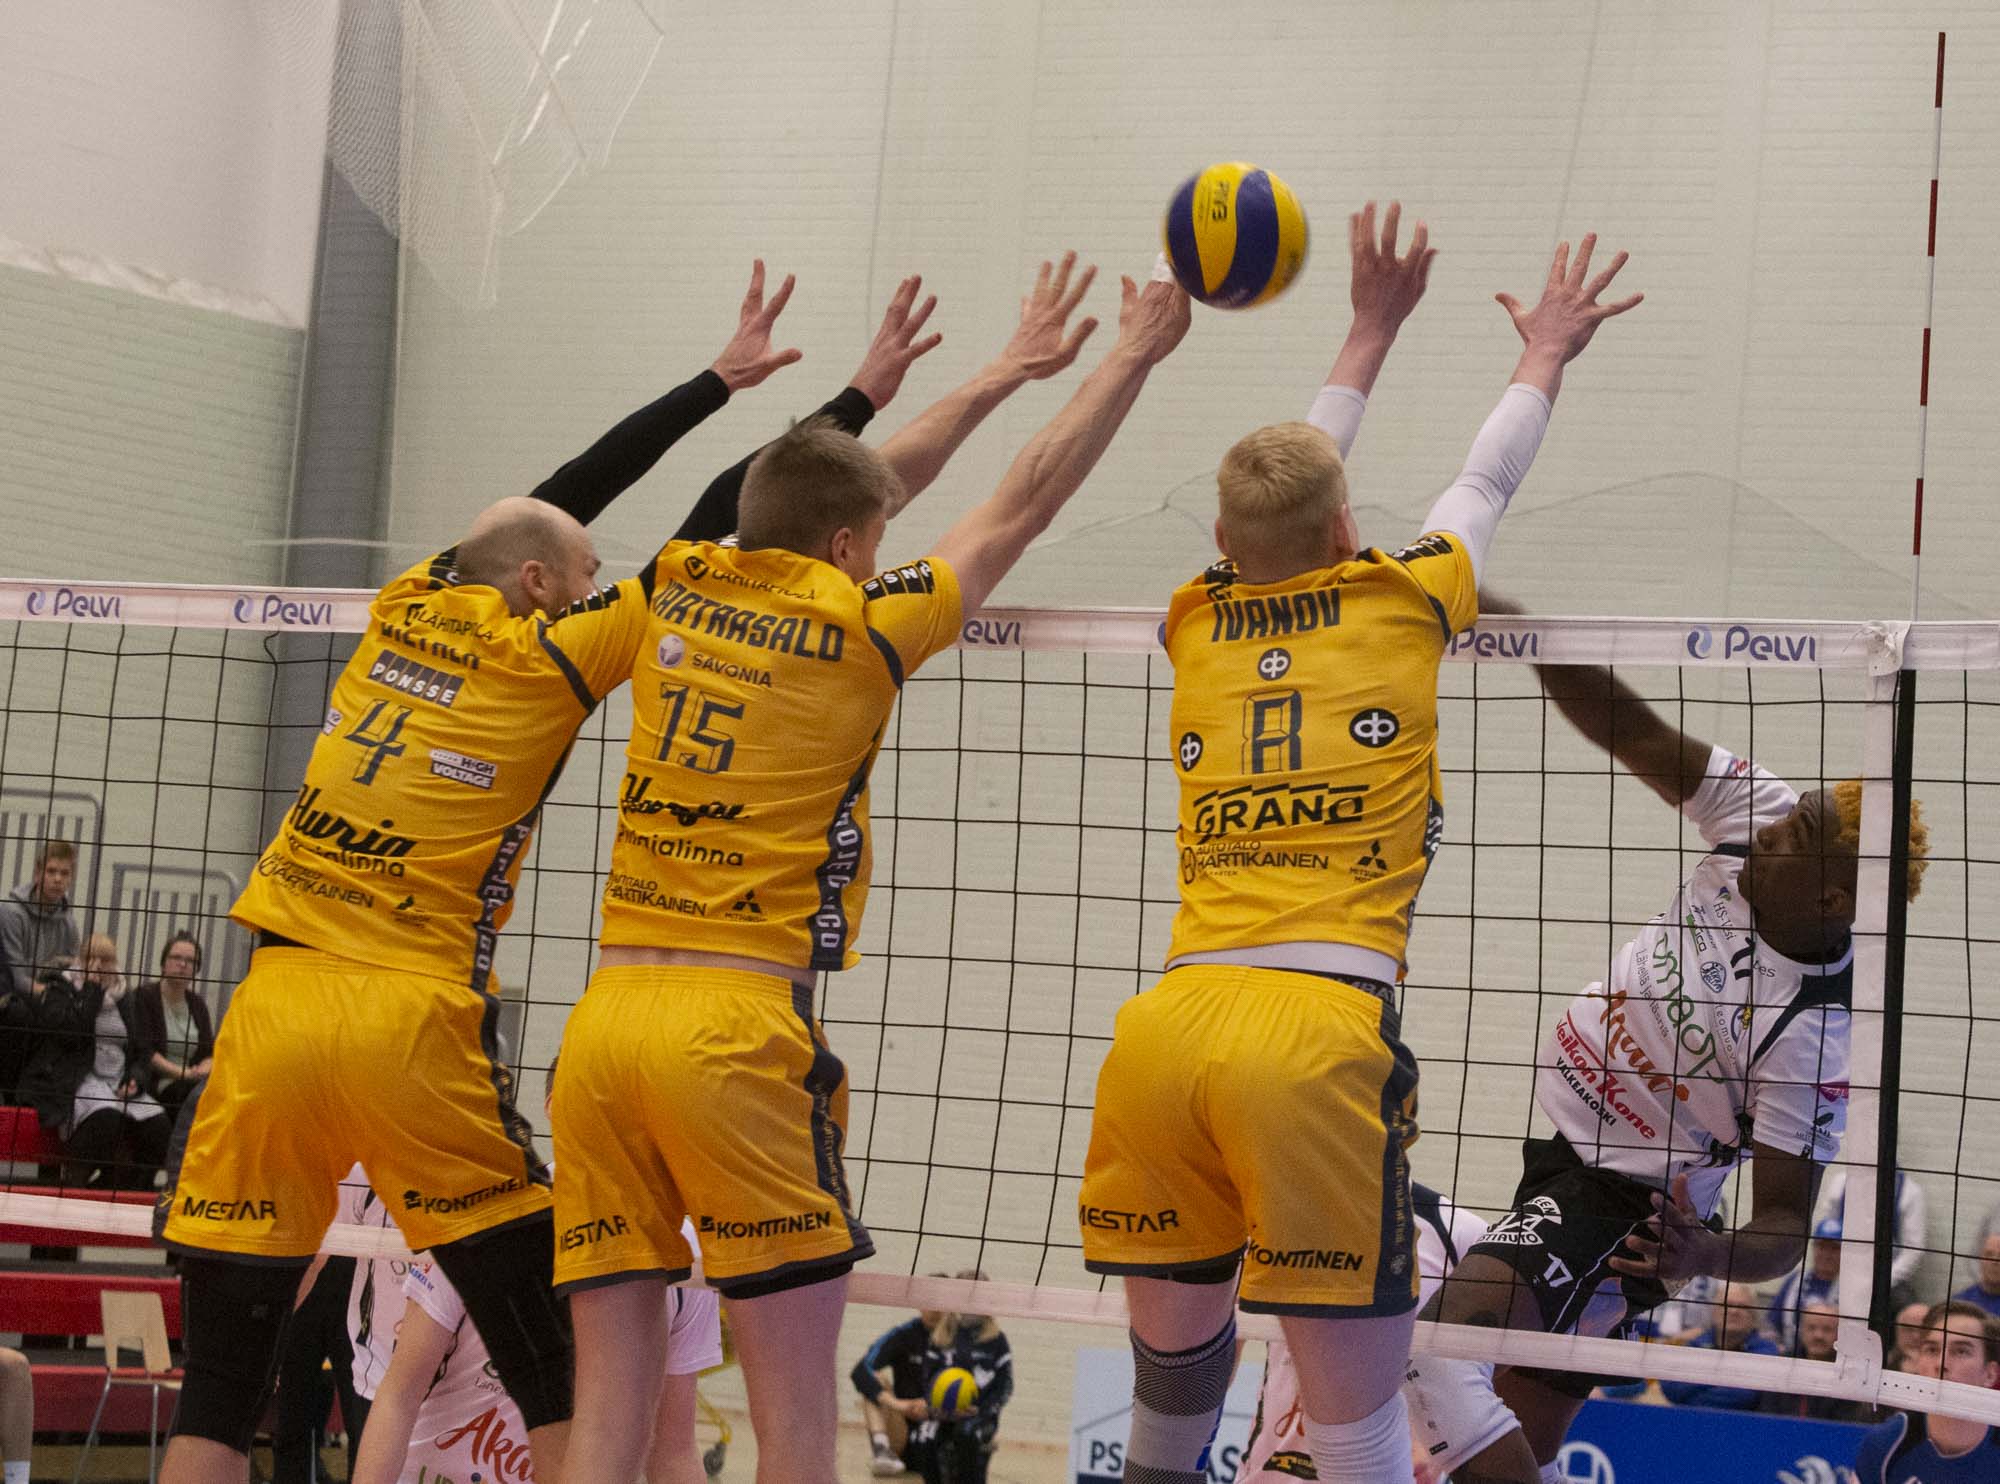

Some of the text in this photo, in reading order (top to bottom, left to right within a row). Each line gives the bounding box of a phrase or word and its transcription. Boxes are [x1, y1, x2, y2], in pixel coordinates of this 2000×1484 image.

[962, 620, 1021, 645] elvi
[1211, 588, 1341, 642] IVANOV
[372, 661, 457, 703] PONSSE
[692, 653, 773, 688] SAVONIA
[344, 699, 413, 786] 4
[654, 682, 745, 774] 15
[1197, 851, 1329, 870] HARTIKAINEN
[1555, 1056, 1617, 1127] VALKEAKOSKI
[1596, 1071, 1656, 1140] Kone
[183, 1197, 277, 1221] MESTAR
[716, 1211, 831, 1240] KONTTINEN
